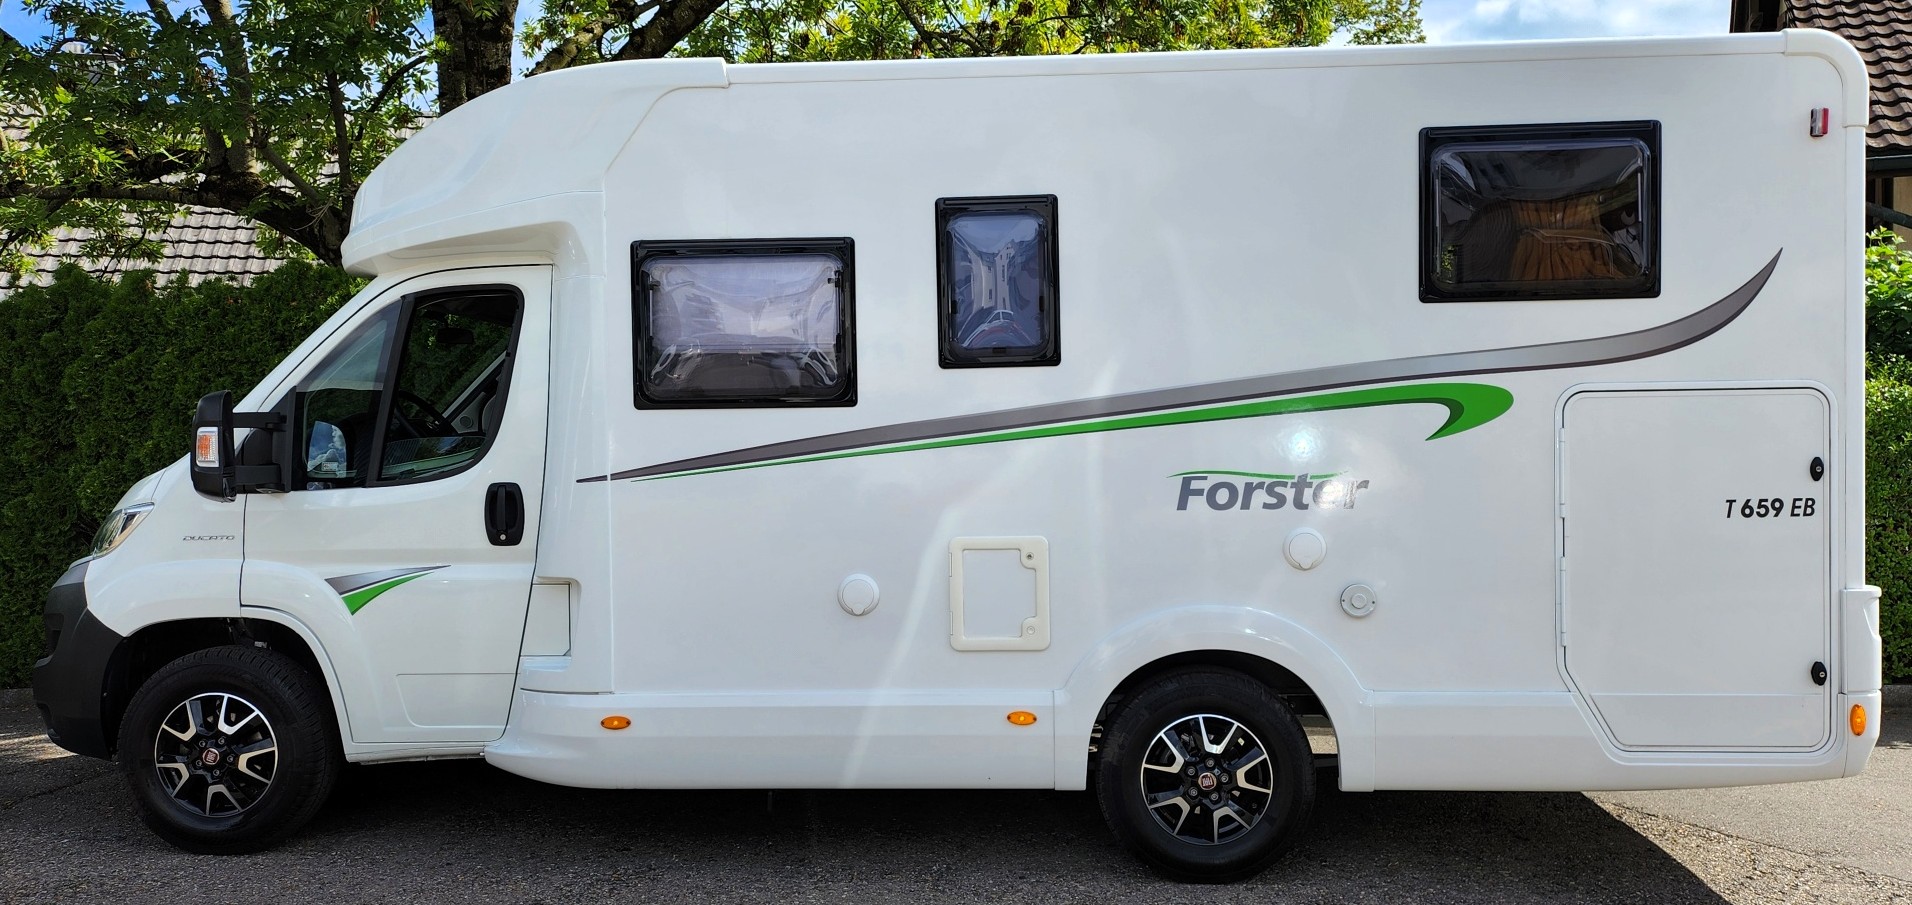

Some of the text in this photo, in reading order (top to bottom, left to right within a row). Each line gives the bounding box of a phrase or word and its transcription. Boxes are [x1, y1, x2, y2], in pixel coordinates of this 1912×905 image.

[1725, 497, 1816, 519] T 659 EB
